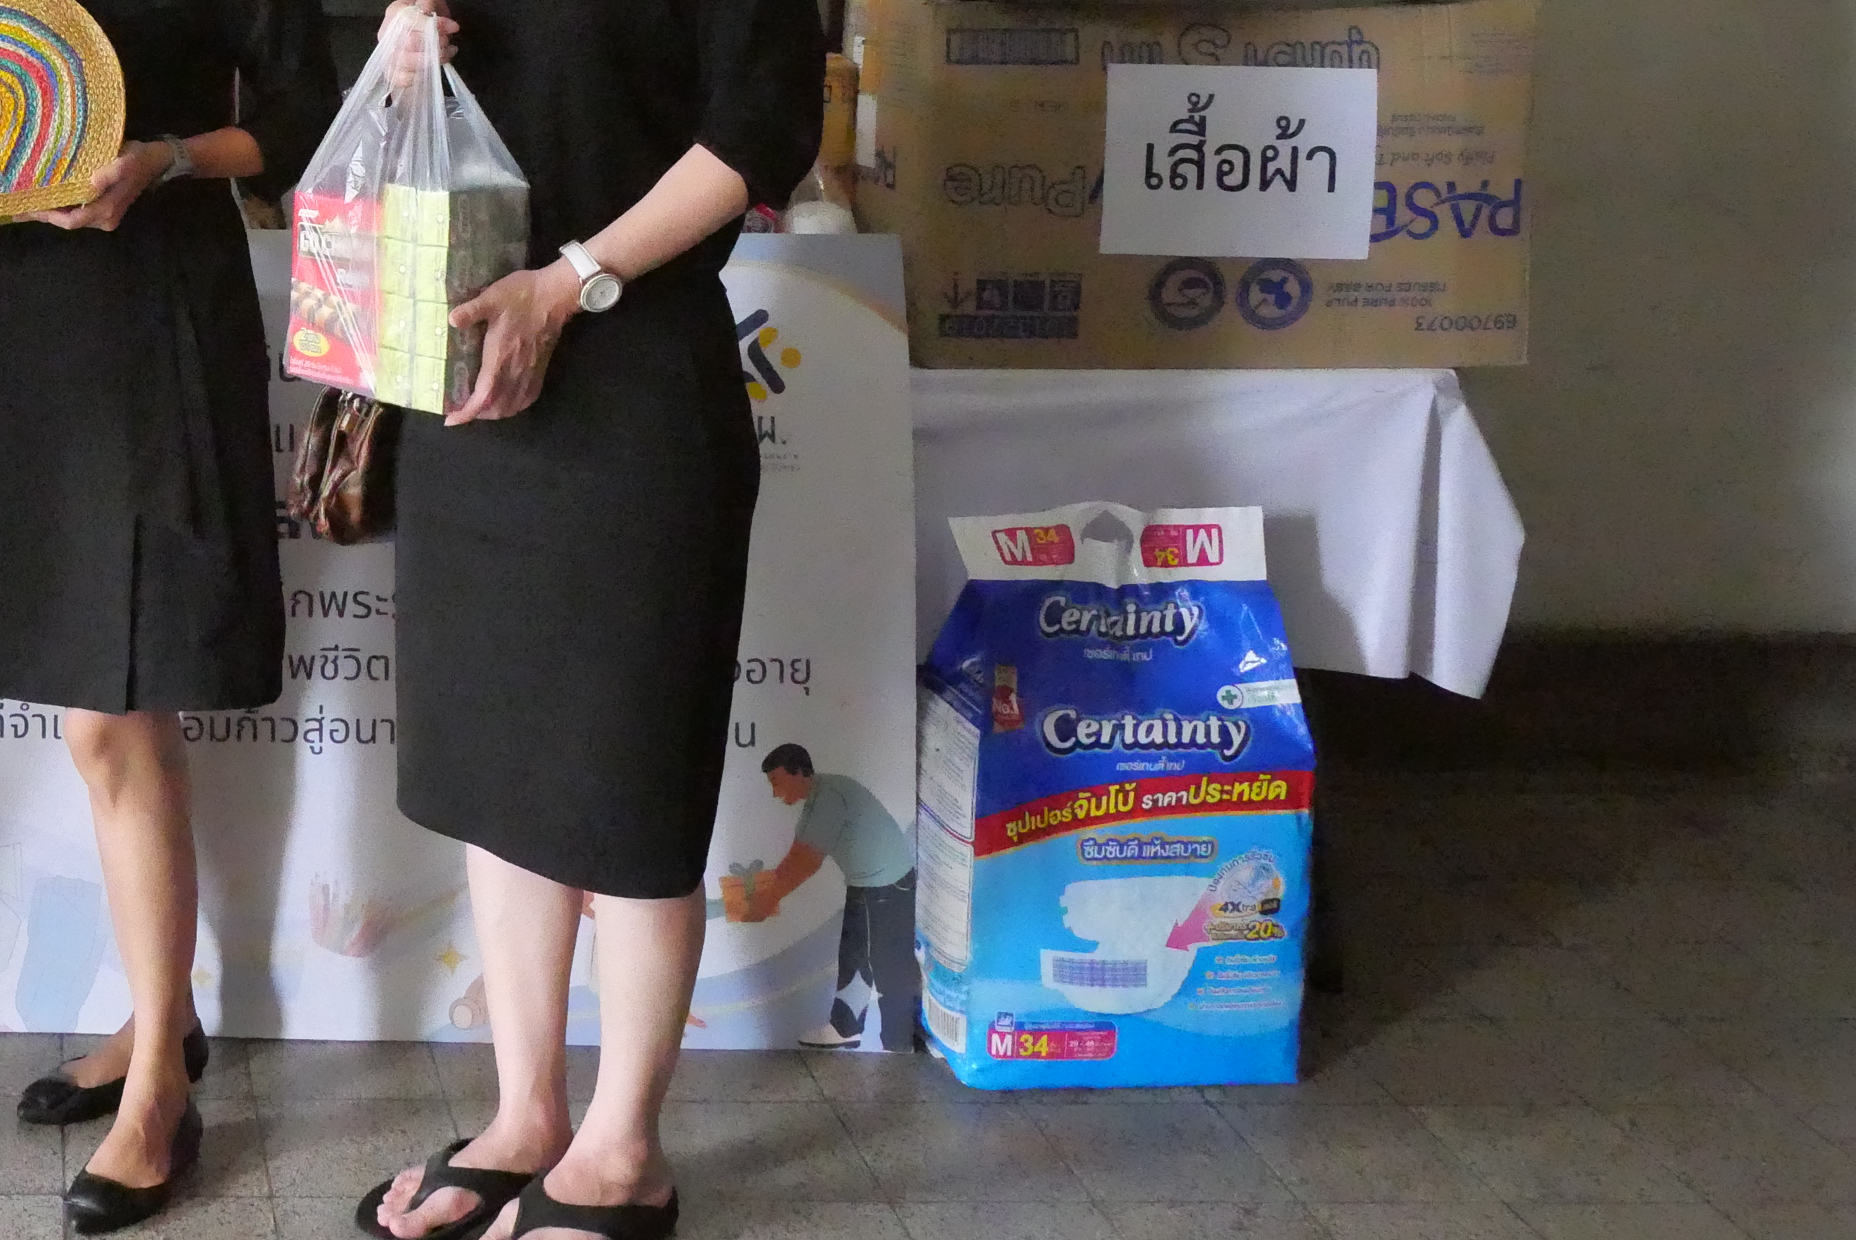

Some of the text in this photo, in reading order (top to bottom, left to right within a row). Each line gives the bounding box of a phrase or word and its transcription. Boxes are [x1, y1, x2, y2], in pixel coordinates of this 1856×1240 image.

[1144, 91, 1337, 195] เสื้อผ้า
[1370, 178, 1523, 243] PASE
[995, 528, 1059, 562] M 34
[291, 589, 395, 619] กพระ
[1039, 594, 1202, 644] Certainty
[182, 704, 396, 755] อมก้าวสู่อนา
[1042, 708, 1247, 758] Certainty
[1005, 773, 1289, 842] ซุปเปอร์จัมโบ้ ราคาประหยัด
[991, 1033, 1049, 1057] M 34
